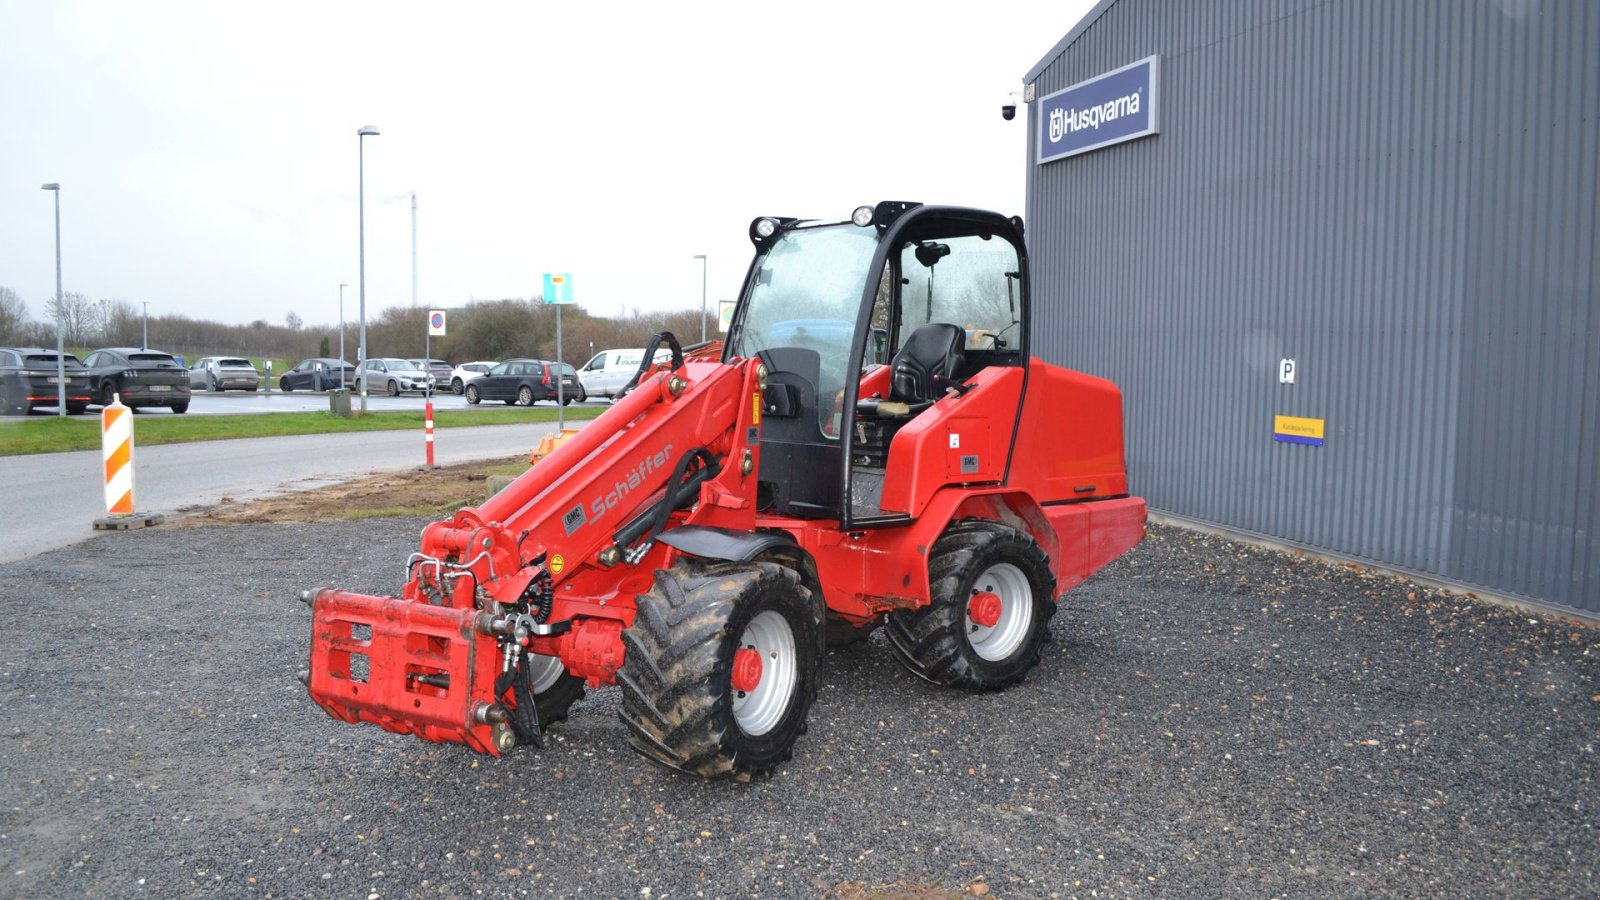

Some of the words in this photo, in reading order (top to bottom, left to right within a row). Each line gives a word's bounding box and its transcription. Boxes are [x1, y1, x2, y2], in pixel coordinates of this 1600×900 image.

[1064, 92, 1140, 134] Husqvarna
[1284, 362, 1293, 379] P
[588, 444, 673, 525] Schäffer
